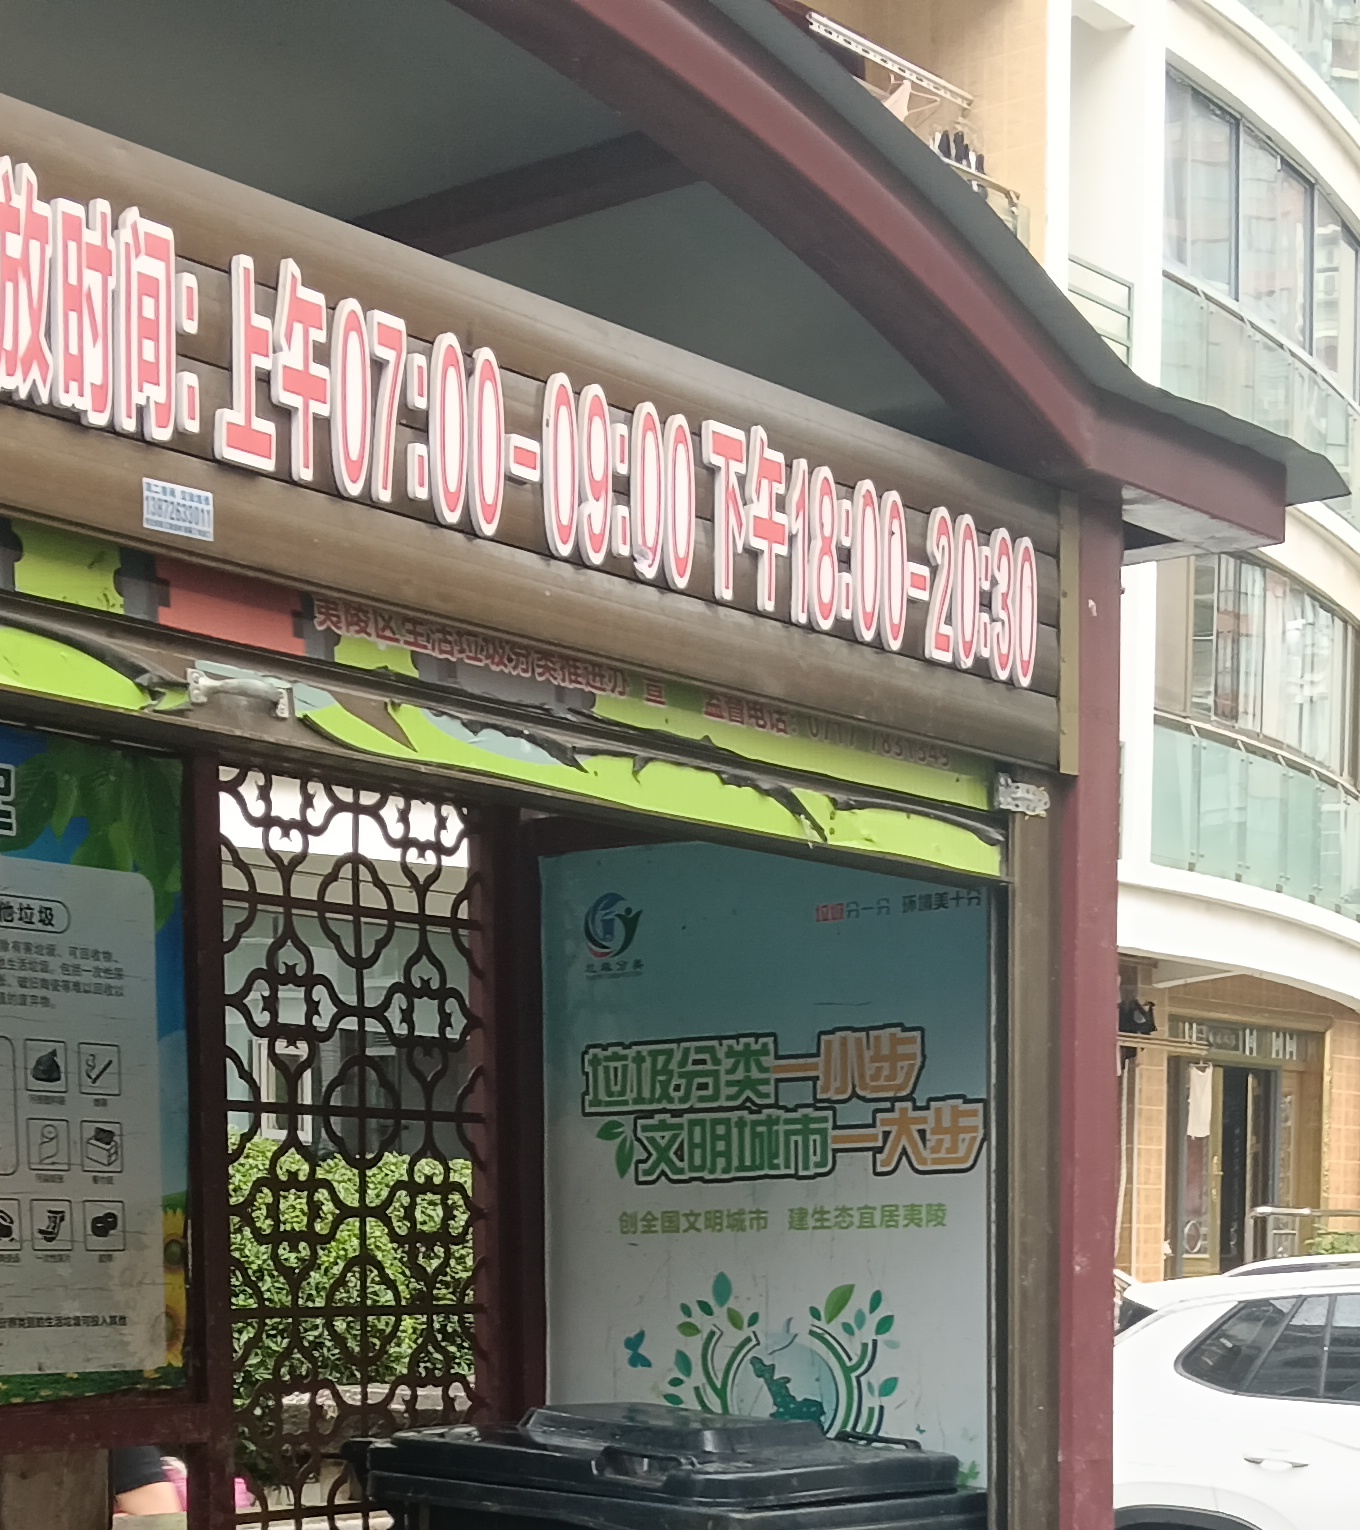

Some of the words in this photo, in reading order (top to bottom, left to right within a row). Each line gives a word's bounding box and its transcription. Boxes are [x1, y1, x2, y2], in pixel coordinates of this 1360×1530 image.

[584, 1025, 924, 1113] 垃圾分类一小步
[637, 1098, 985, 1182] 文明城市一大步
[618, 1209, 769, 1235] 创全国文明城市
[788, 1202, 948, 1231] 建生态宜居夷陵
